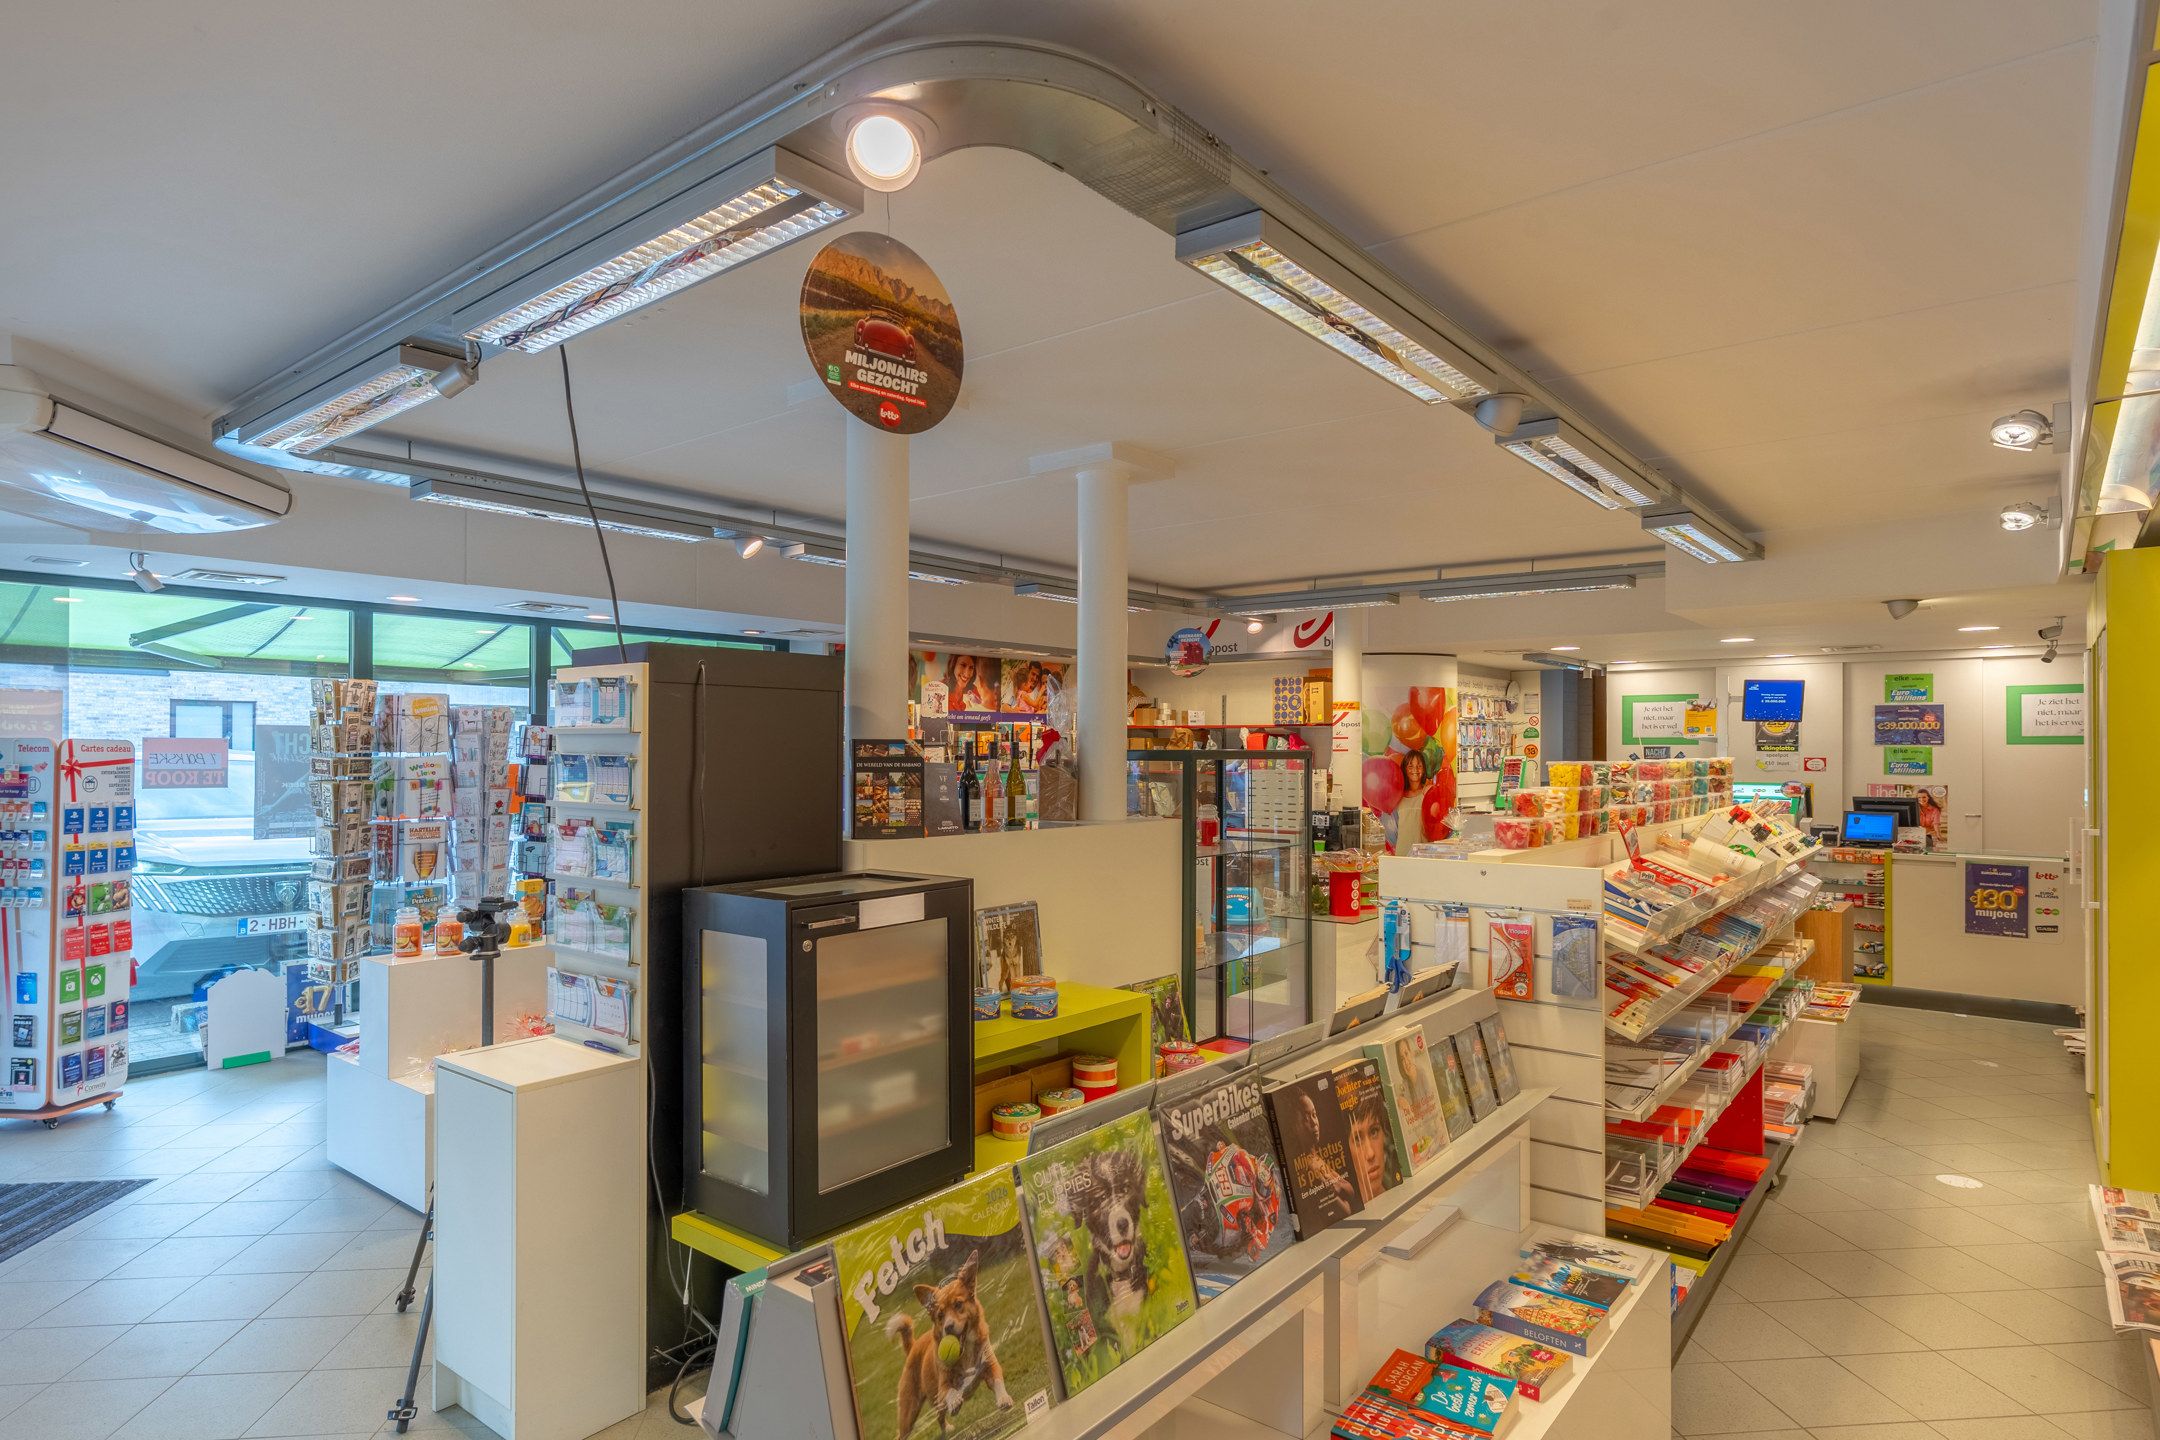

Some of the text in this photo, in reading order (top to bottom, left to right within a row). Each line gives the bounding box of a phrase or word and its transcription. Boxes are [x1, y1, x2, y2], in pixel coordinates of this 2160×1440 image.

[845, 350, 928, 384] MILJONAIRS
[857, 368, 919, 395] GEZOCHT
[880, 408, 899, 420] lotto
[2065, 697, 2080, 705] het
[18, 744, 50, 753] Telecom
[80, 744, 131, 753] Cartes cadeau
[1868, 785, 1912, 797] Libelle
[1196, 858, 1209, 866] ost
[2035, 872, 2059, 880] lotto
[1975, 909, 2018, 920] miljoen
[84, 1081, 107, 1092] Conway
[1170, 1082, 1261, 1140] SuperBikes
[1340, 1095, 1358, 1111] ungle
[1037, 1172, 1092, 1208] PUPPIES
[971, 1198, 1011, 1223] CALENDAR
[853, 1210, 949, 1325] Fetch
[1523, 1328, 1568, 1348] BELOFTEN
[1384, 1360, 1411, 1385] SARAH
[1392, 1360, 1426, 1395] MORGAN
[1430, 1391, 1449, 1406] De
[1446, 1393, 1464, 1414] beste
